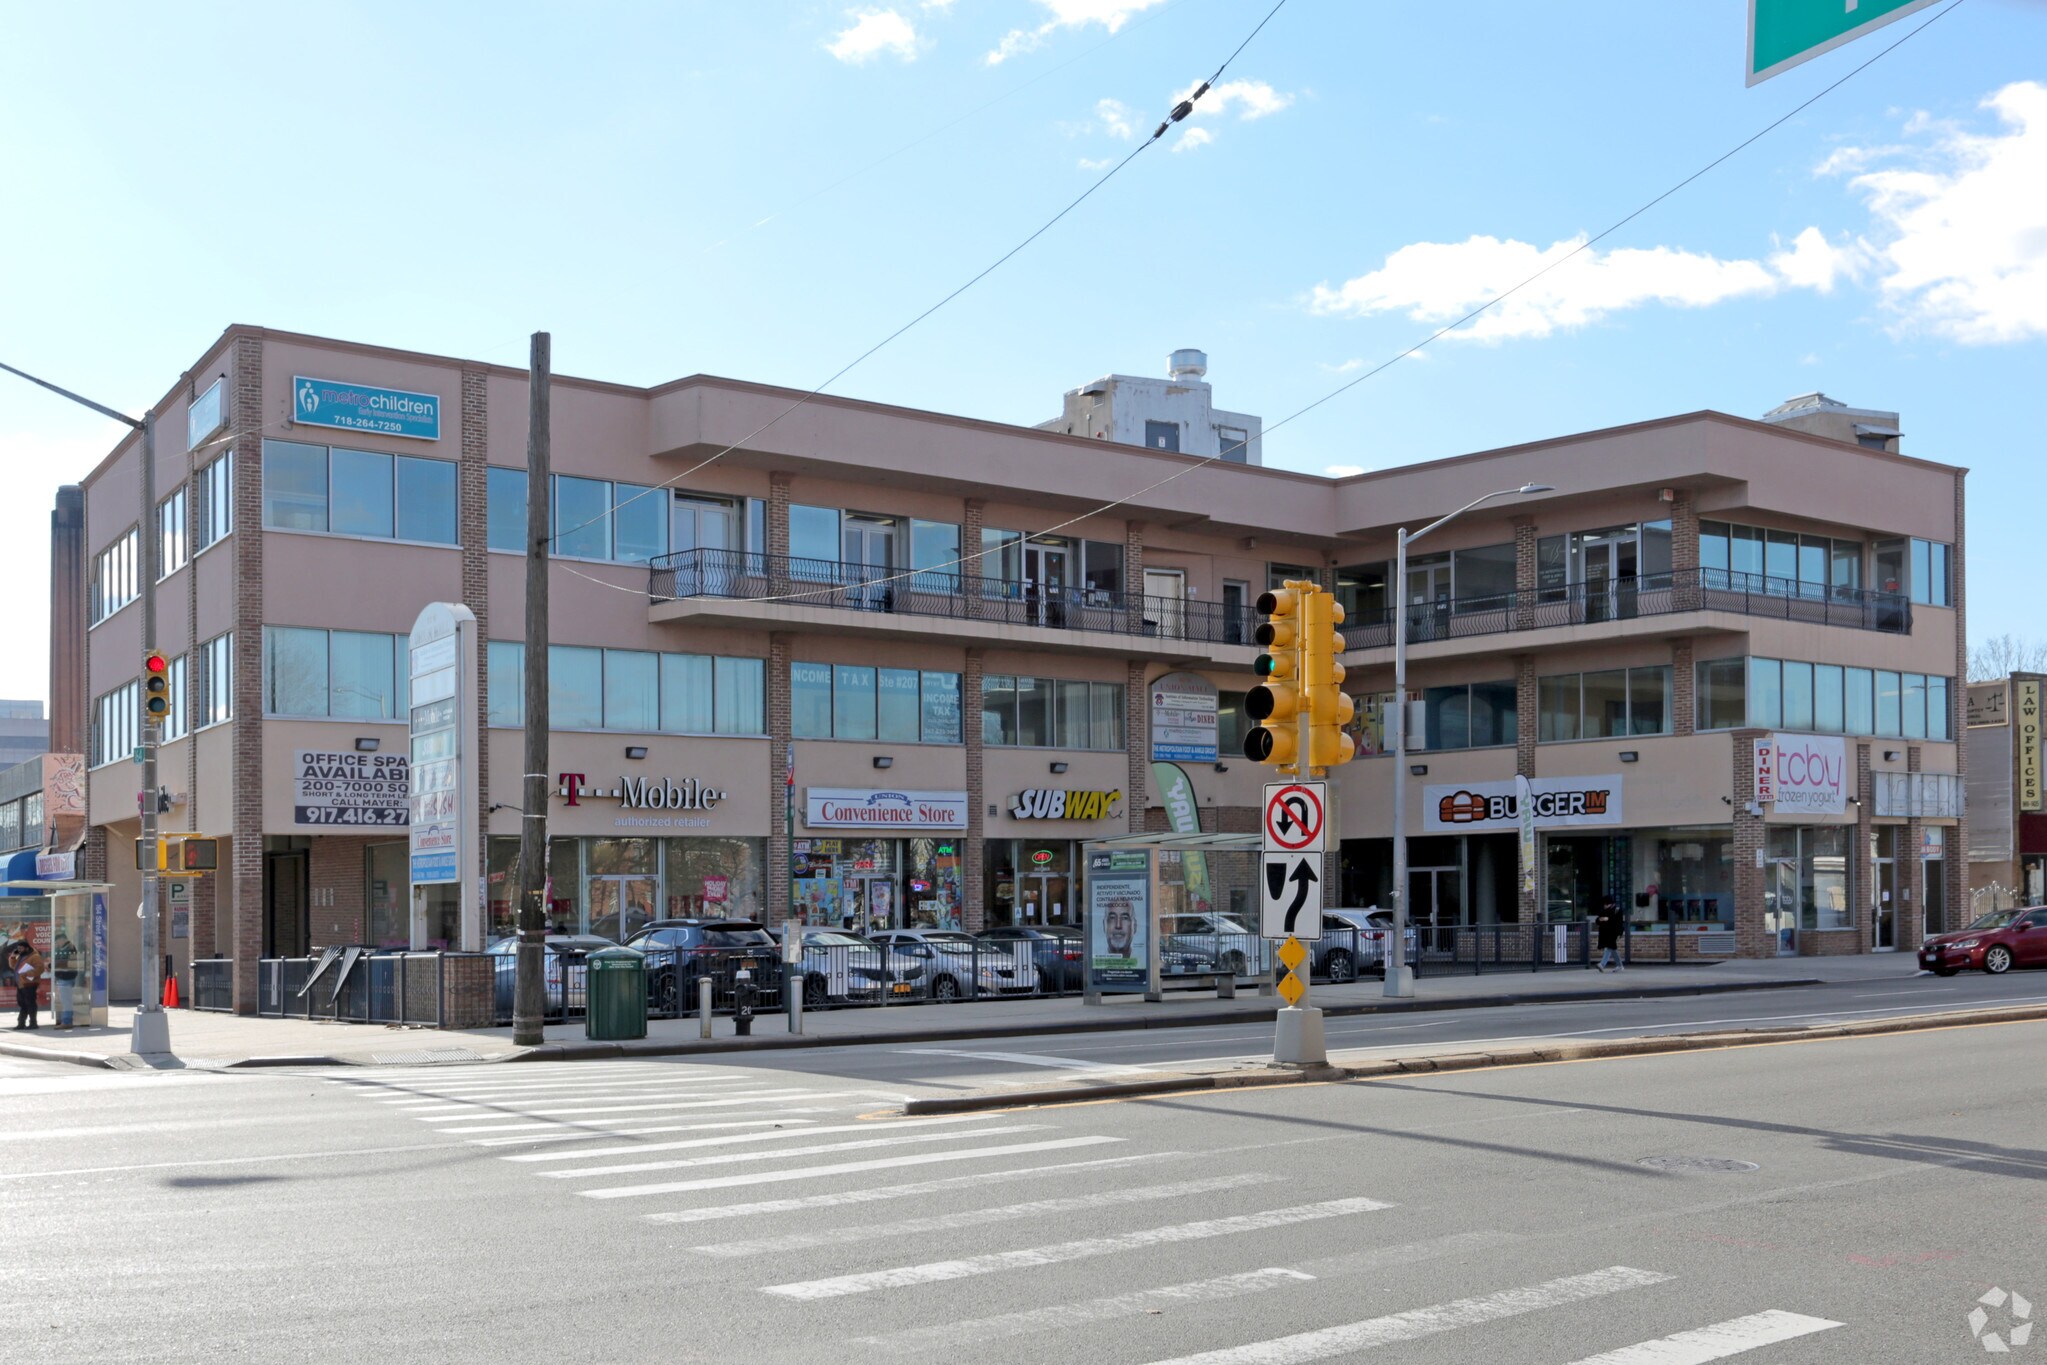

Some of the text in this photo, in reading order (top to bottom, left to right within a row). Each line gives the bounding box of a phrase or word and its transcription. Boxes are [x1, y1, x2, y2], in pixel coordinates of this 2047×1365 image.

[322, 389, 434, 415] metrochildren
[334, 415, 402, 432] 718-264-7250
[793, 669, 918, 690] NCOME TAX Ste #207
[923, 693, 960, 705] INCOME
[2023, 686, 2037, 716] LAW
[932, 706, 951, 717] TAX
[1197, 714, 1215, 724] DINER
[302, 753, 408, 767] OFFICE SPA
[2024, 724, 2036, 798] OFFICES
[1758, 748, 1771, 794] DINER
[1777, 744, 1842, 796] tcby
[302, 781, 409, 793] 200-7000 SQ
[331, 798, 403, 807] CALL MAYER:
[1014, 789, 1121, 819] SUBWAY
[1777, 787, 1836, 806] frozen yogurt
[306, 807, 408, 825] 917.416.27
[821, 801, 955, 822] Convenience Store
[614, 816, 711, 827] authorized retailer
[1034, 853, 1050, 861] OPEN
[94, 916, 102, 934] Street
[741, 1006, 751, 1016] 20
